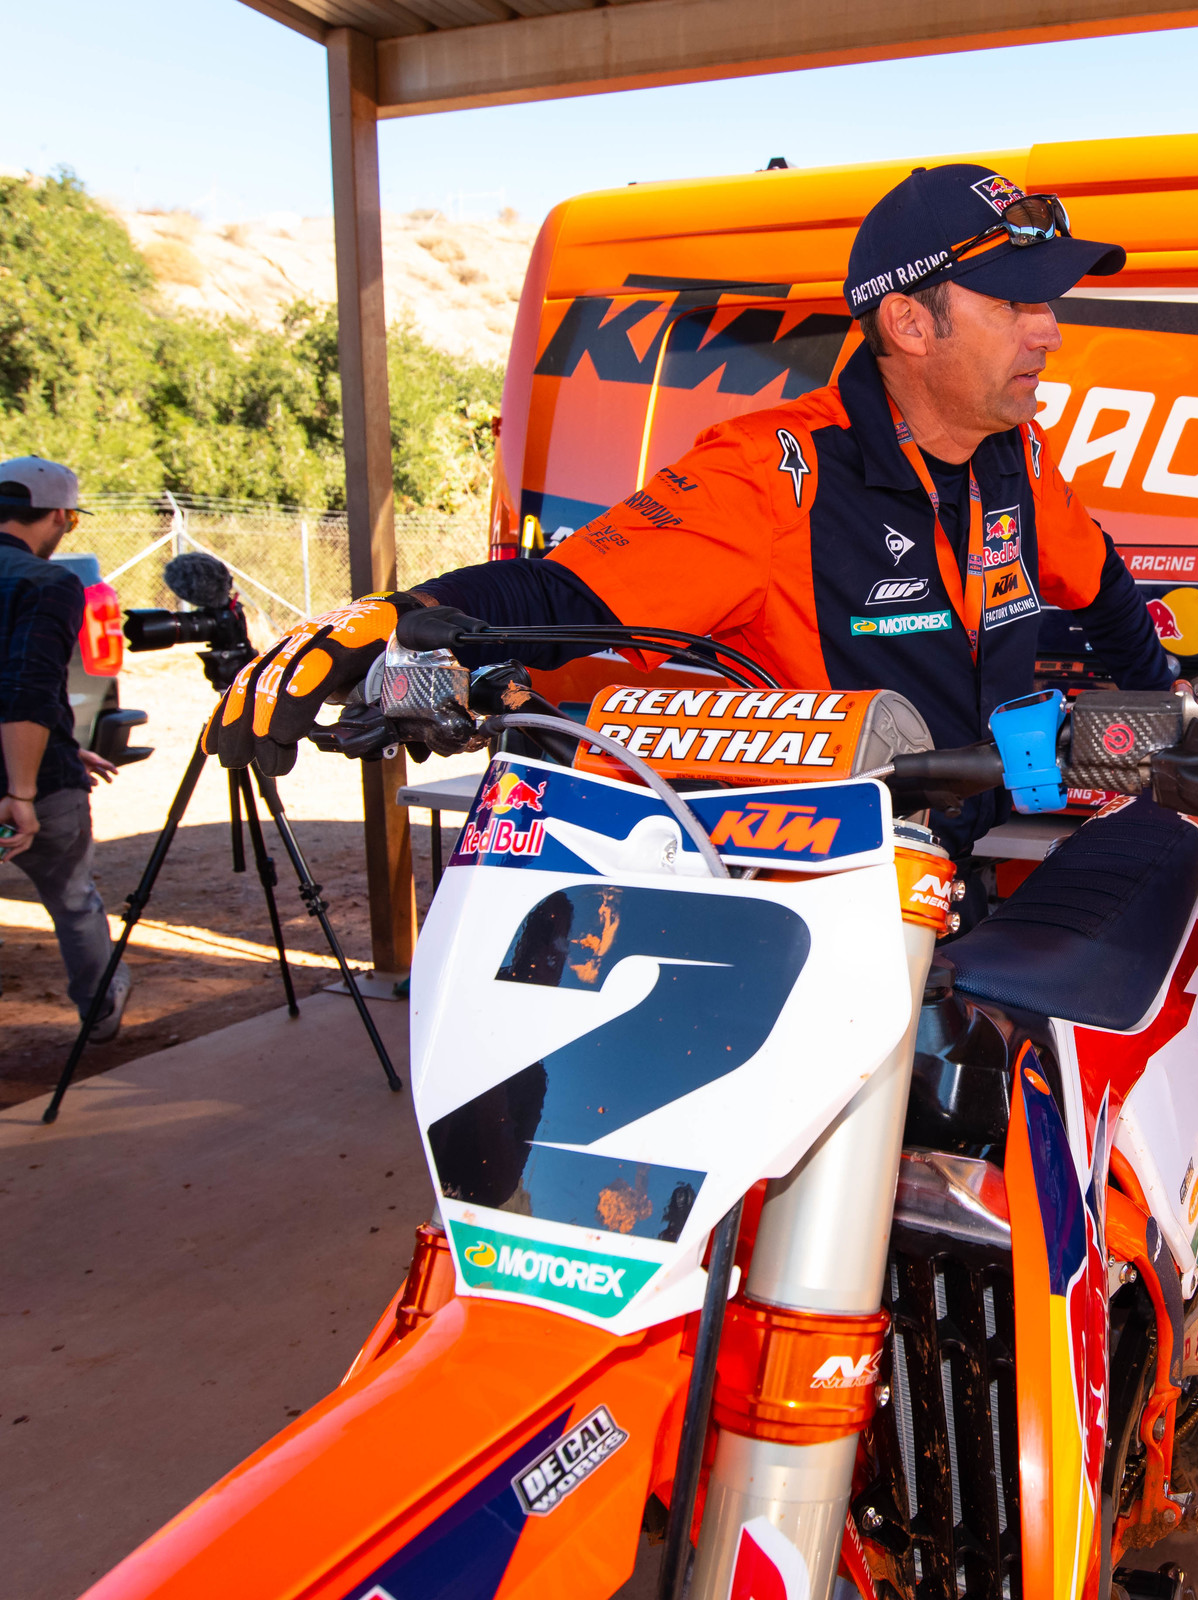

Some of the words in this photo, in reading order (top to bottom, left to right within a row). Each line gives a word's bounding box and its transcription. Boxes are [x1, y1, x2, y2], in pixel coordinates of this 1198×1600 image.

[850, 271, 895, 307] FACTORY
[533, 273, 855, 400] KTM
[983, 541, 1008, 567] Red
[1008, 537, 1021, 563] Bull
[874, 581, 927, 601] WP
[991, 571, 1019, 599] KTM
[878, 612, 949, 634] MOTOREX
[985, 606, 1008, 624] FACTORY
[1009, 597, 1035, 615] RACING
[600, 687, 848, 722] RENTHAL
[586, 722, 837, 767] RENTHAL
[459, 818, 498, 855] Red
[492, 819, 547, 856] Bull
[709, 801, 841, 855] KTM
[909, 891, 950, 912] NEKE
[427, 883, 812, 1244] 2
[497, 1246, 627, 1299] MOTOREX
[531, 1431, 624, 1511] WORKS
